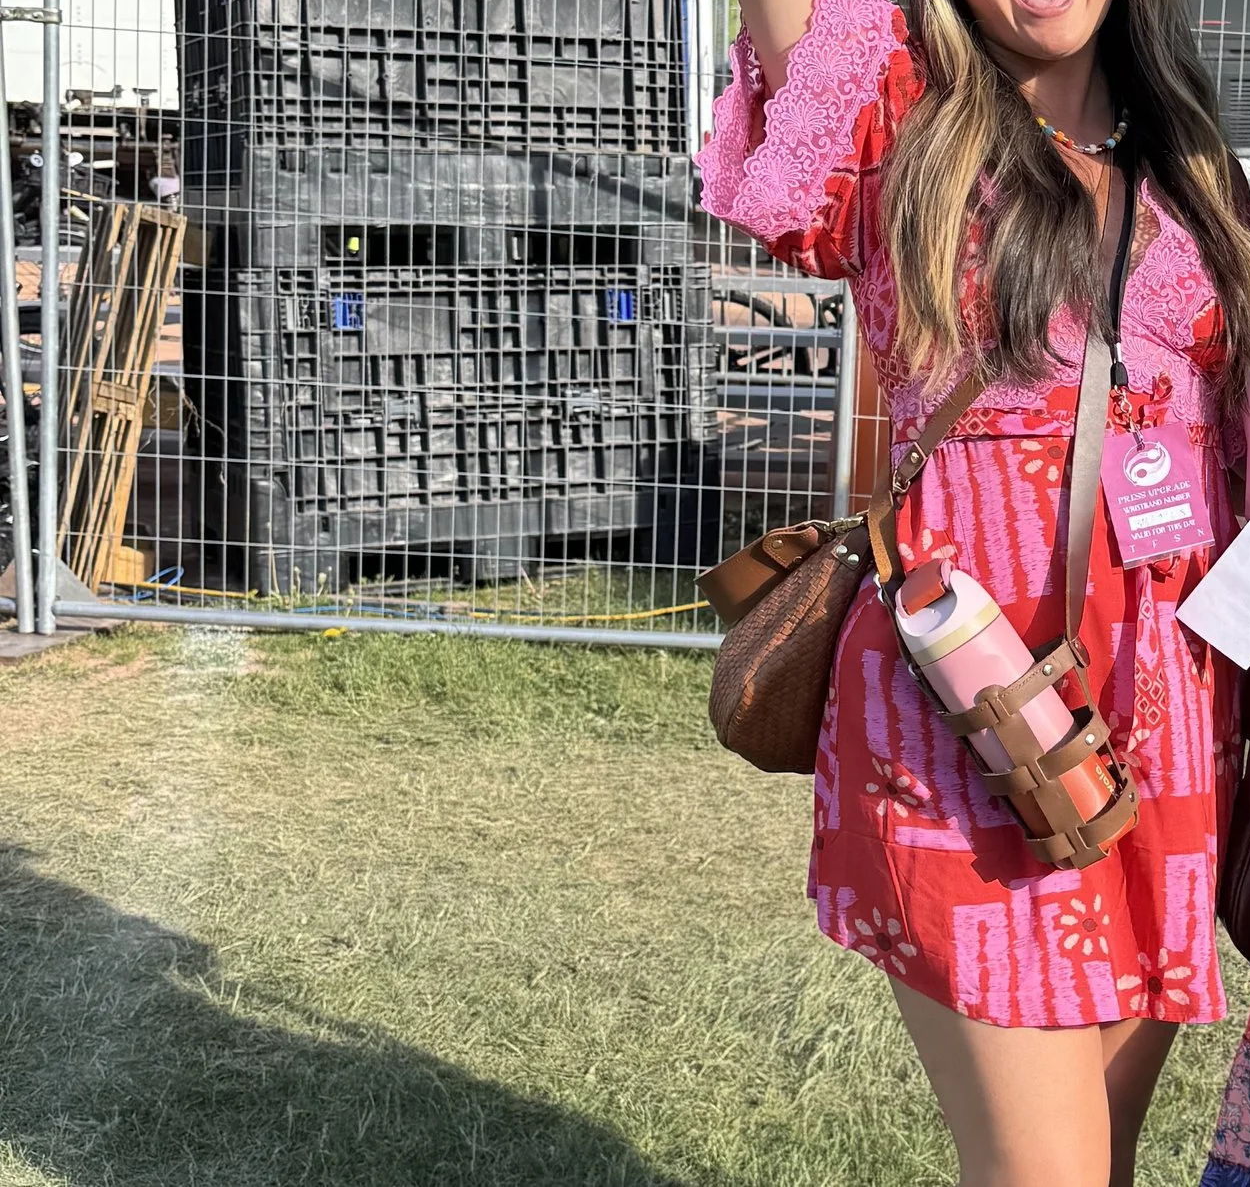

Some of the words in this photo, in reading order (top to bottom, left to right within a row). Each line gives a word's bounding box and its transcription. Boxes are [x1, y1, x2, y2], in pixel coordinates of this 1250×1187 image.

[1117, 491, 1147, 504] PRESS
[1148, 480, 1191, 497] UPGRADE
[1122, 498, 1163, 513] WRISTBAND
[1163, 492, 1191, 505] NUMBER
[1130, 530, 1151, 540] VALID
[1152, 526, 1166, 536] FOR
[1167, 523, 1183, 532] THIS
[1183, 519, 1196, 529] DAY
[1174, 533, 1181, 542] S
